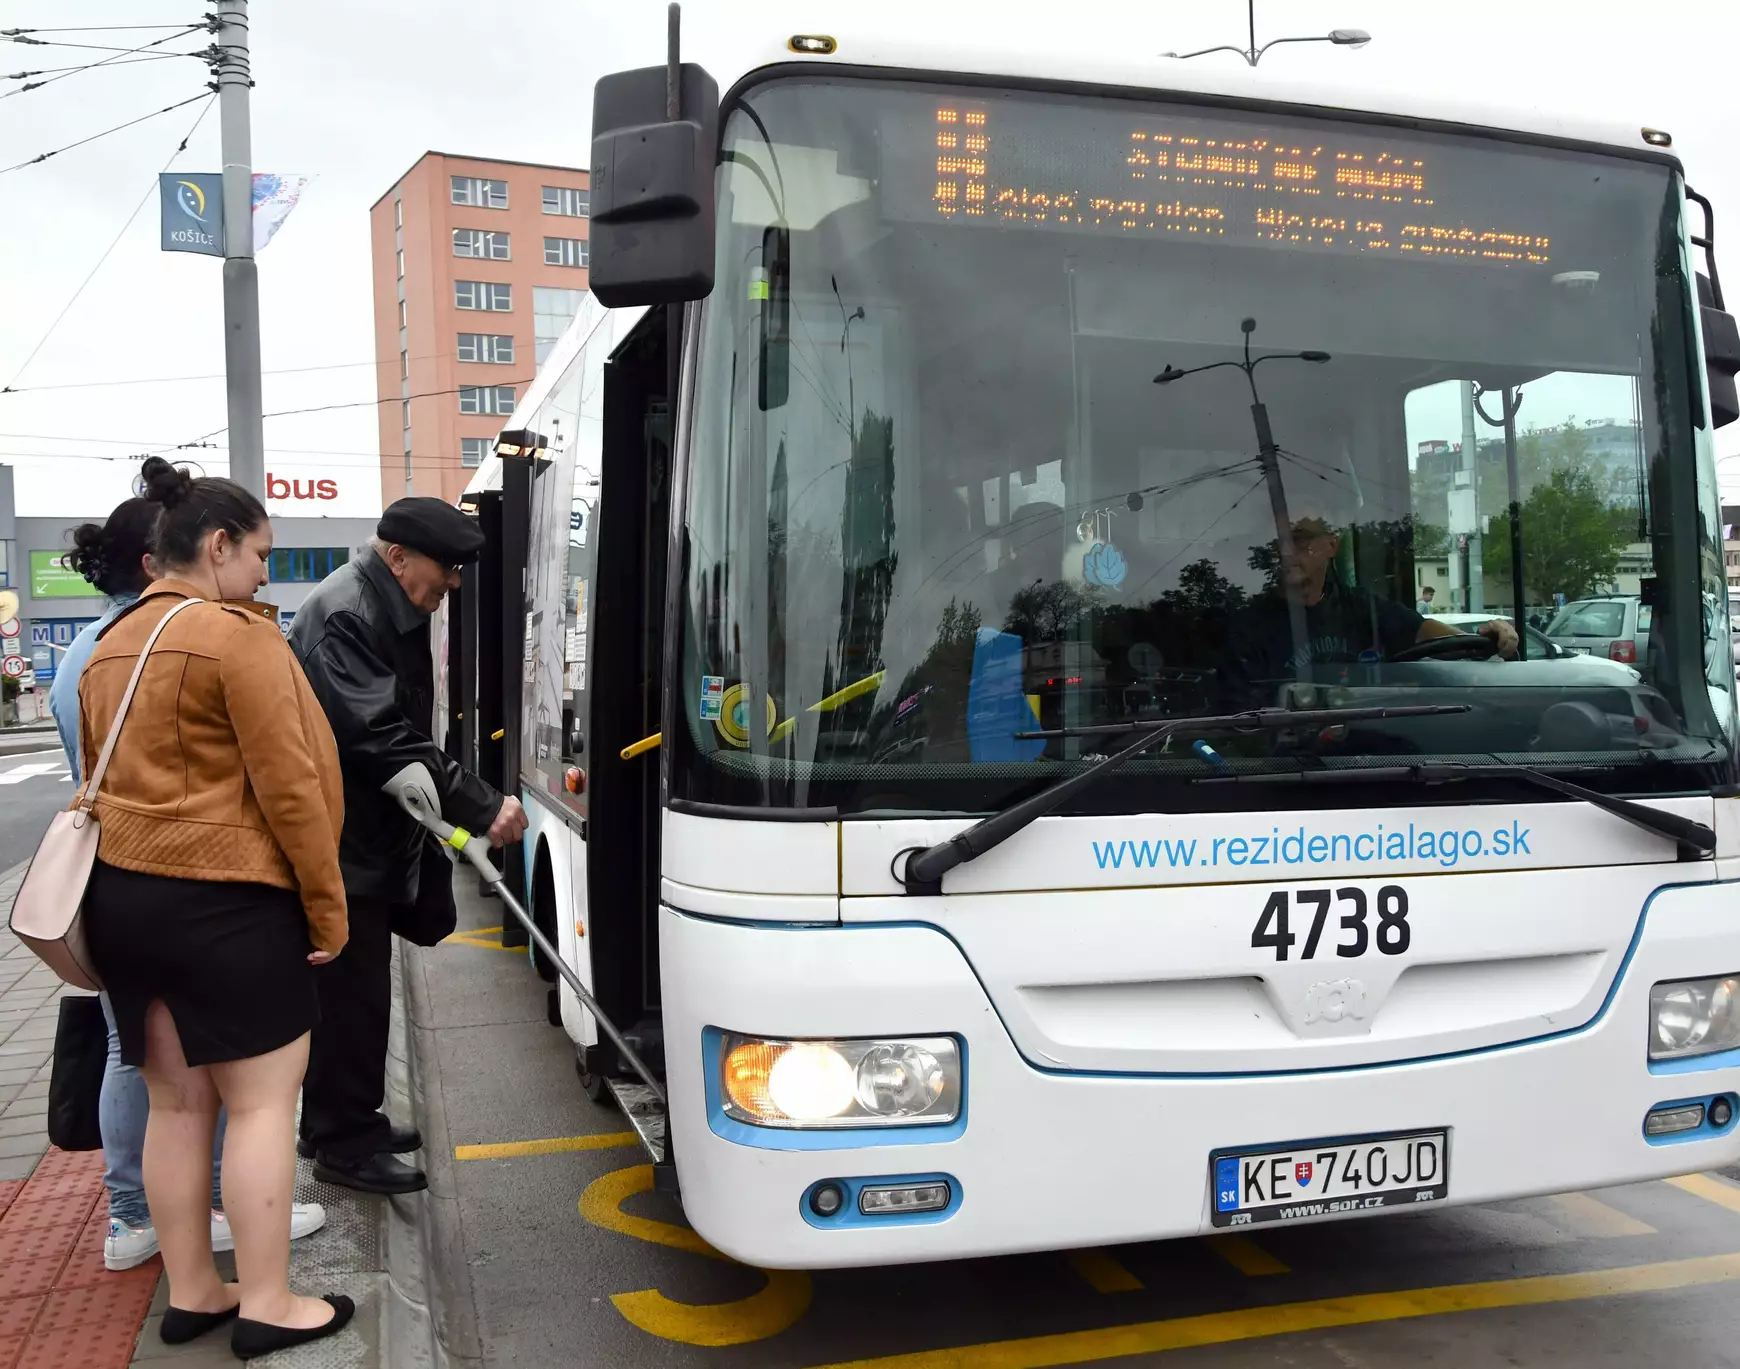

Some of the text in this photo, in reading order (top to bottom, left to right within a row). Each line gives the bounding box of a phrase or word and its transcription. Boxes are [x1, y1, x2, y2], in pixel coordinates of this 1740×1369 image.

[171, 229, 214, 245] KOŠICE
[266, 473, 338, 499] bus
[1092, 820, 1532, 869] www.rezidencialago.sk
[1251, 885, 1410, 962] 4738
[1244, 1157, 1292, 1203] KE
[1221, 1190, 1236, 1203] SK
[1279, 1195, 1384, 1219] www.sor.cz
